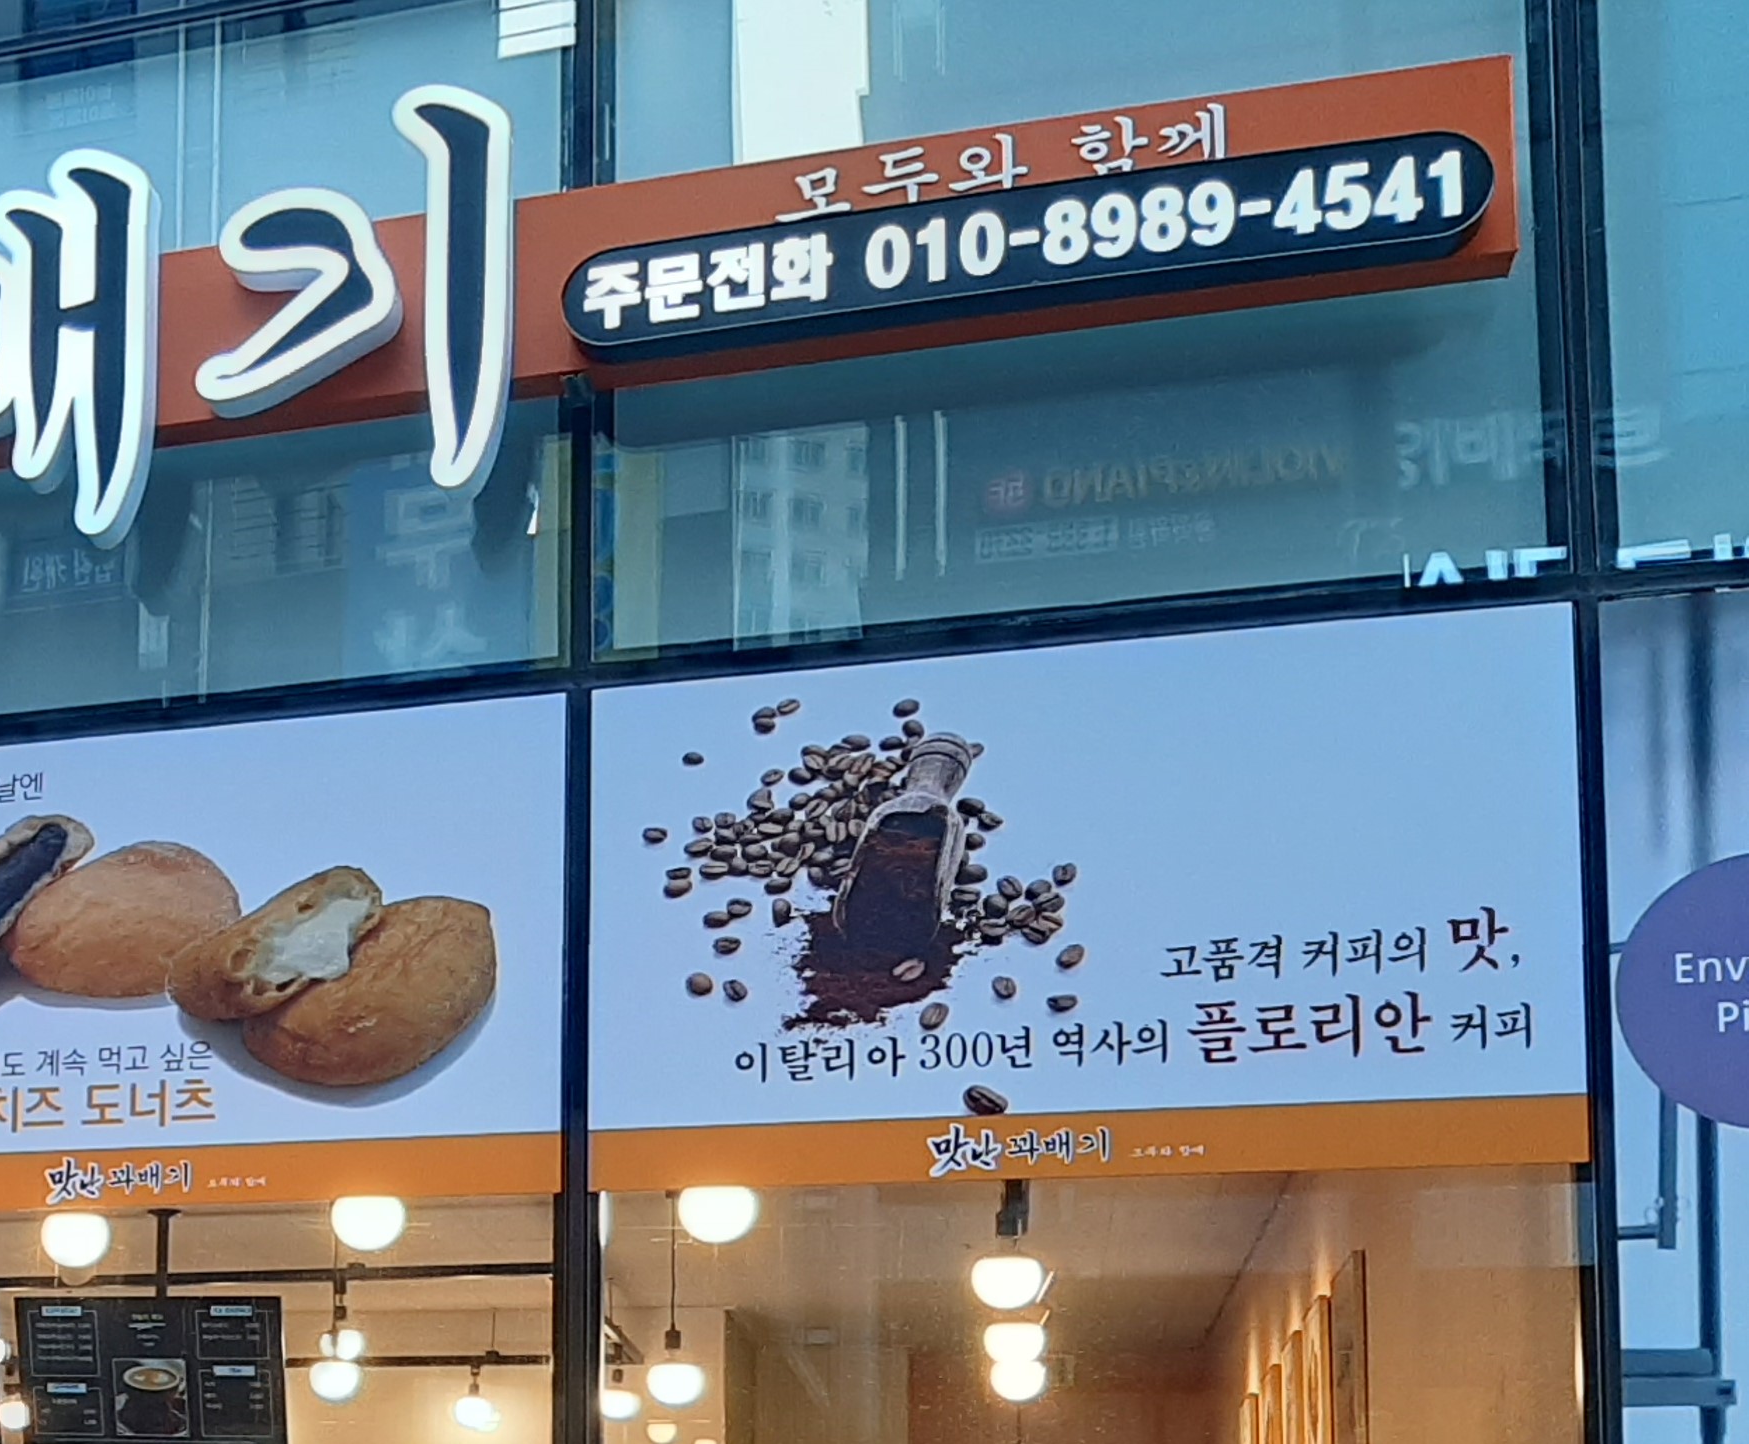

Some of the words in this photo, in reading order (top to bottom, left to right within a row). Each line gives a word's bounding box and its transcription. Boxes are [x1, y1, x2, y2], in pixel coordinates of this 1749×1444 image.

[775, 132, 1029, 223] 모두와
[1070, 102, 1227, 176] 함께
[582, 231, 834, 330] 주문전화
[863, 149, 1464, 290] 010-8989-4541
[1160, 934, 1283, 983] 고품격
[1301, 926, 1427, 978] 커피의
[1446, 905, 1520, 973] 맛,
[1674, 952, 1749, 984] Env
[35, 1048, 88, 1078] 계속
[98, 1044, 150, 1075] 먹고
[159, 1040, 214, 1073] 싶은
[734, 1035, 906, 1083] 이탈리아
[918, 1025, 1033, 1071] 300년
[1052, 1018, 1169, 1068] 역사의
[1186, 990, 1432, 1064] 플로리안
[1450, 1002, 1533, 1050] 커피
[80, 1078, 217, 1128] 도너츠
[927, 1122, 1001, 1178] 맛난
[1005, 1126, 1111, 1165] 꽈배기
[45, 1156, 104, 1205] 맛난
[107, 1159, 193, 1195] 꽈배기
